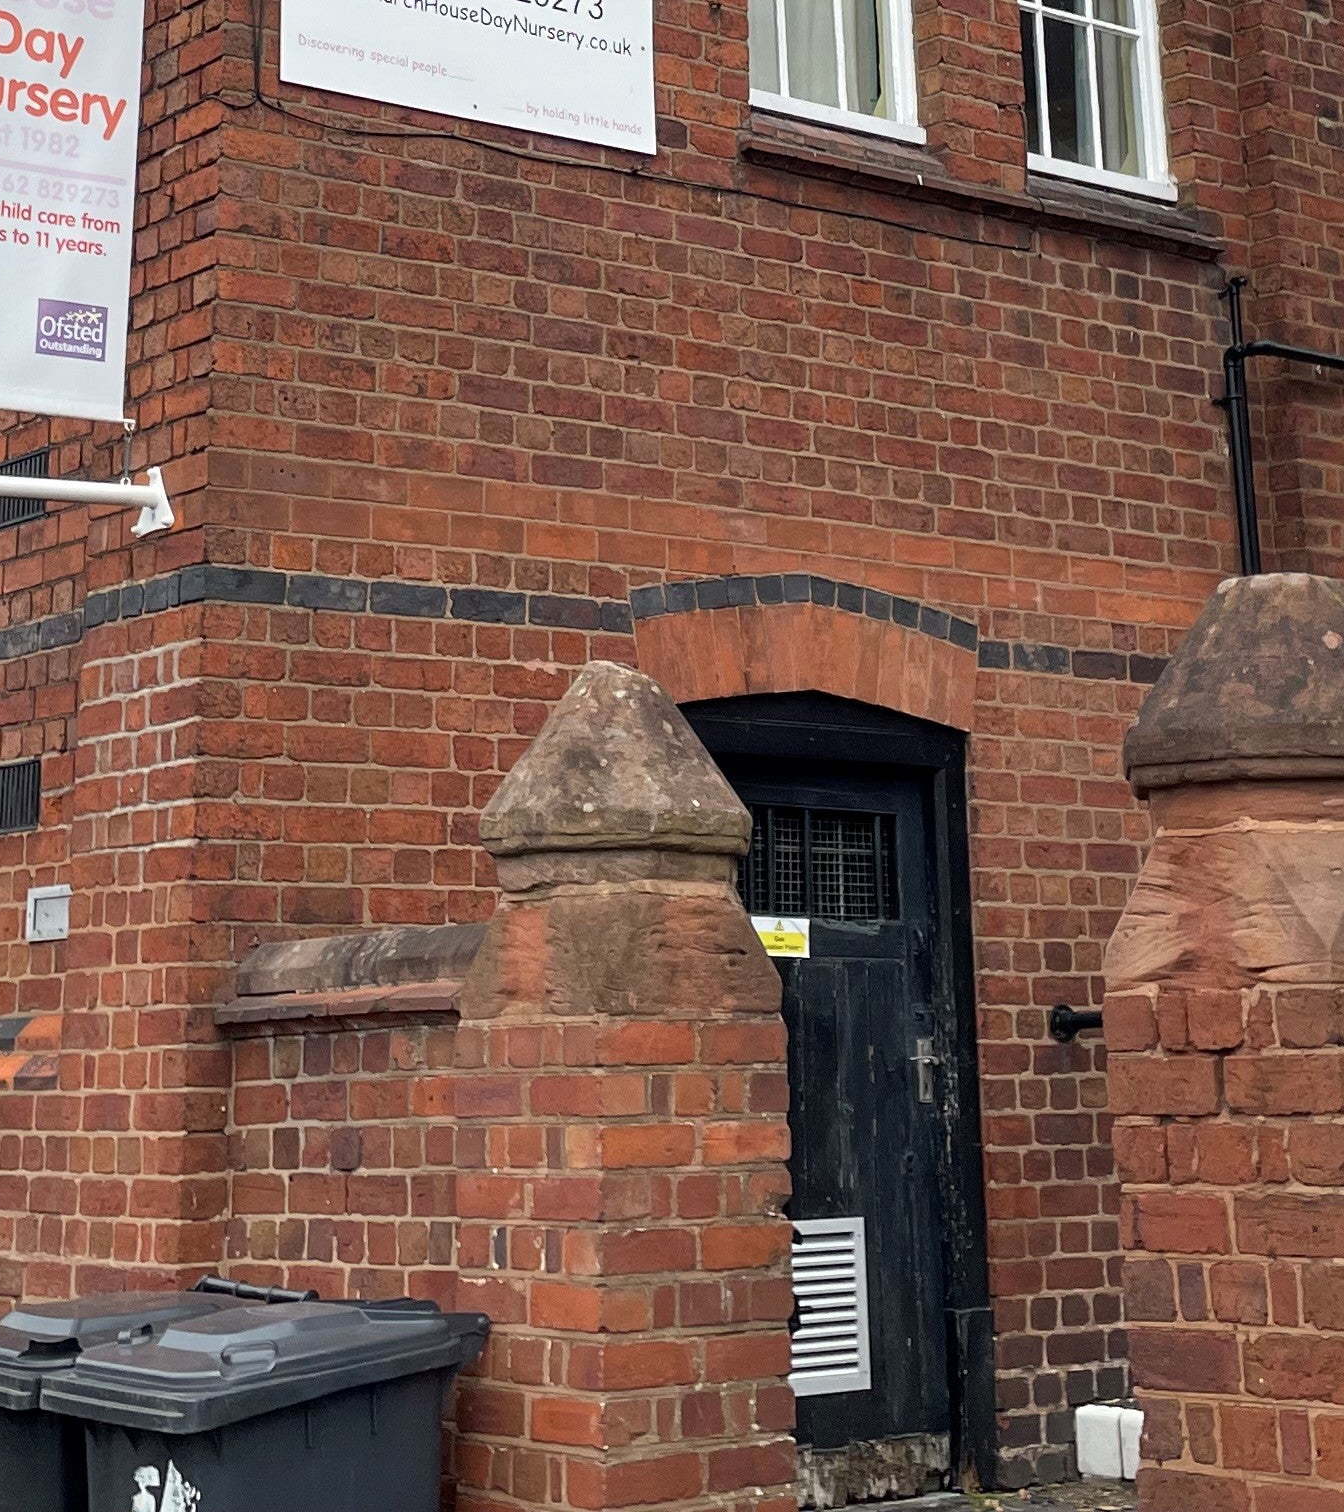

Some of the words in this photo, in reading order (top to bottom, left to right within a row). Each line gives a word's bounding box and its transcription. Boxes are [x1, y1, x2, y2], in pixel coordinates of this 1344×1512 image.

[298, 33, 365, 62] Discovering
[370, 50, 409, 69] special
[542, 105, 580, 126] holding
[583, 112, 610, 130] little
[612, 120, 643, 136] hands
[20, 125, 81, 159] 1982
[37, 177, 120, 209] 829273
[38, 210, 76, 228] care
[81, 212, 121, 234] from
[12, 228, 30, 245] to
[35, 231, 50, 248] 11
[56, 236, 107, 256] years.
[39, 314, 105, 344] Ofsted
[39, 337, 104, 360] Outstanding
